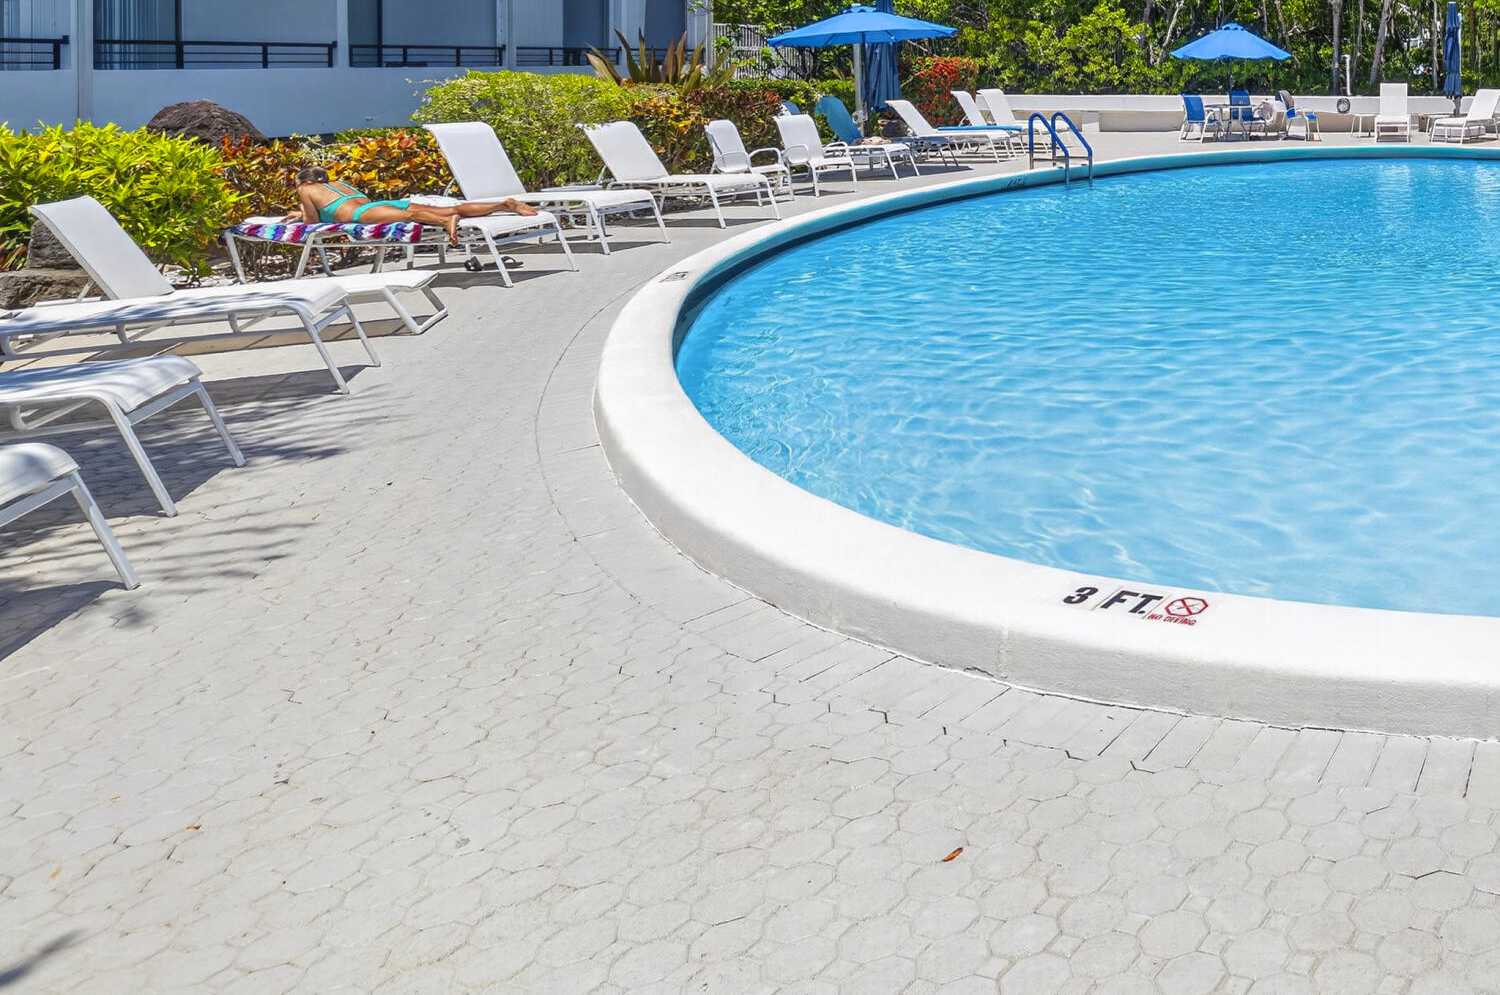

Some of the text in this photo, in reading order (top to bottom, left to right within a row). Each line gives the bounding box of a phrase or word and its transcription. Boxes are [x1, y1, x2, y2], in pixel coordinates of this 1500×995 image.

[1063, 587, 1163, 614] 3 FT.
[1164, 616, 1197, 626] DIVING
